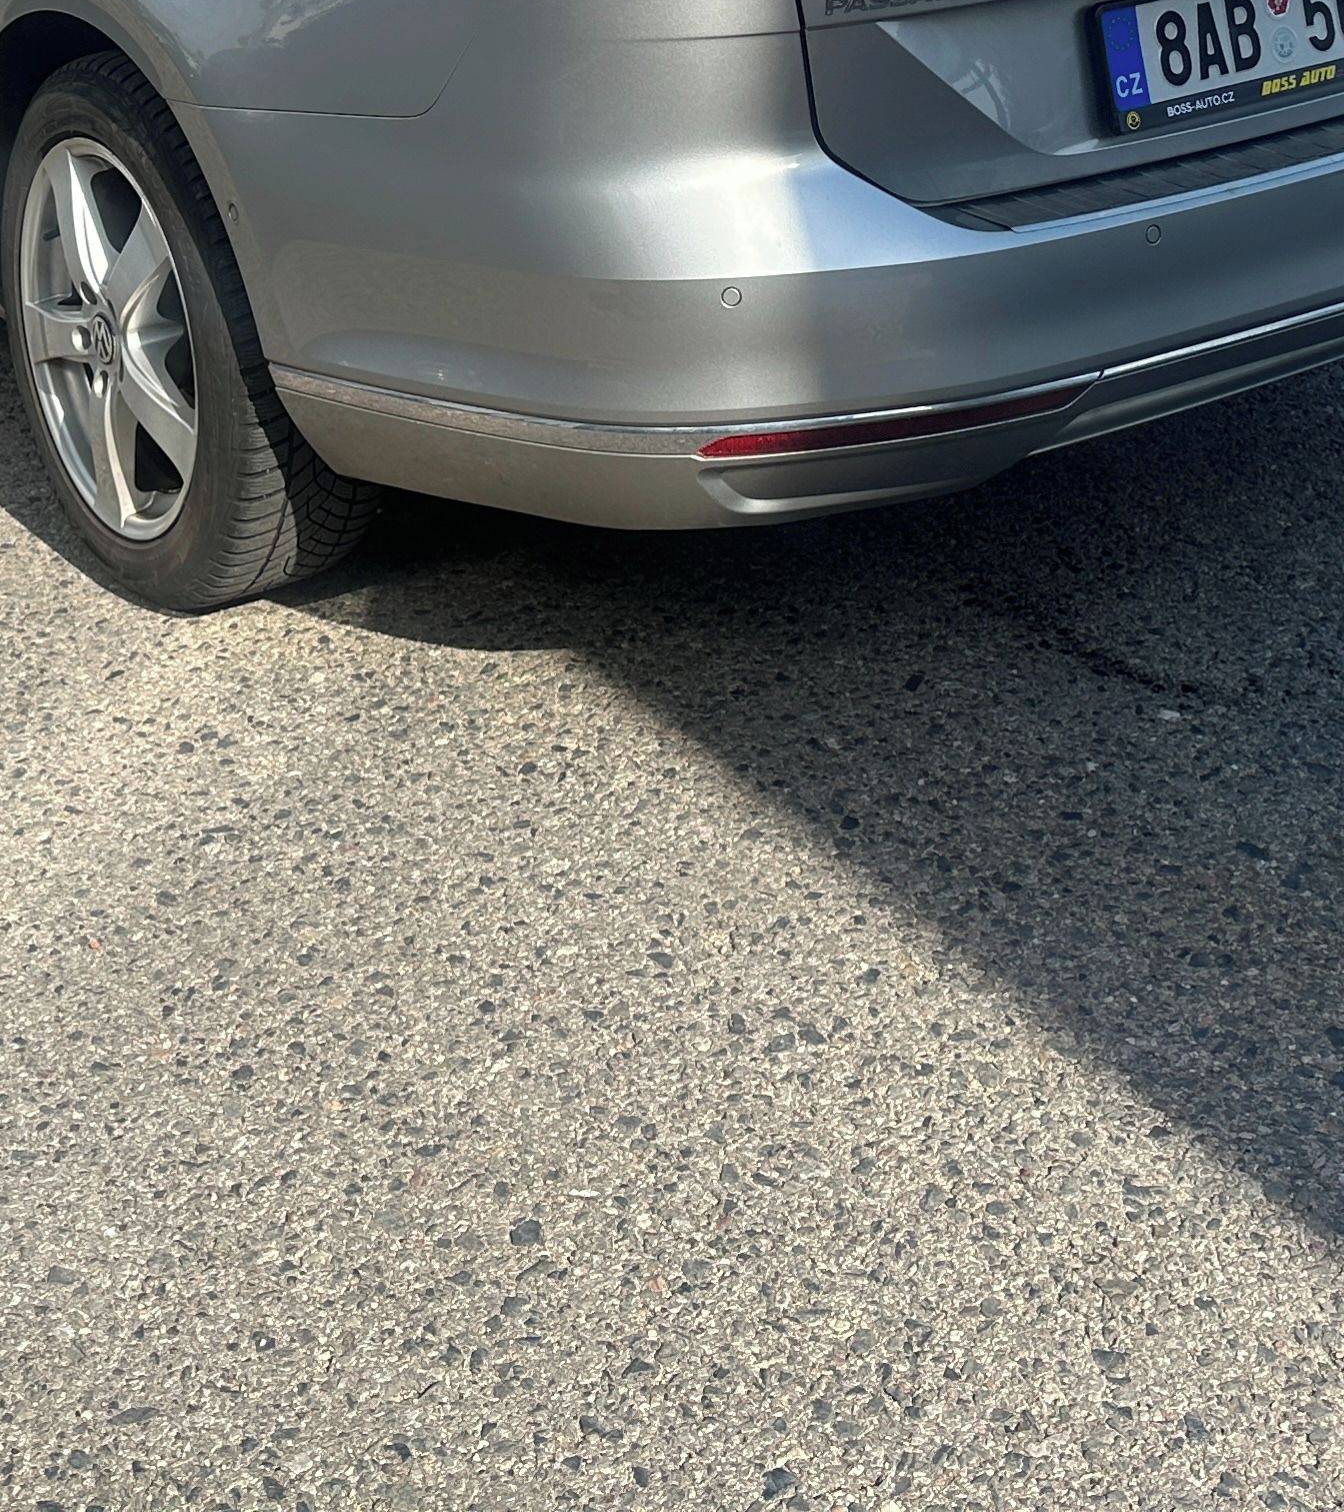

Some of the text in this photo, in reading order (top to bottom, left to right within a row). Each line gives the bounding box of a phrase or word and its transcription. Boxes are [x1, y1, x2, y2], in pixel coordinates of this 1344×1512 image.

[1115, 72, 1144, 98] CZ
[1261, 64, 1337, 96] BOSS AUTO
[1166, 91, 1236, 118] BOSS-AUTO.CZ
